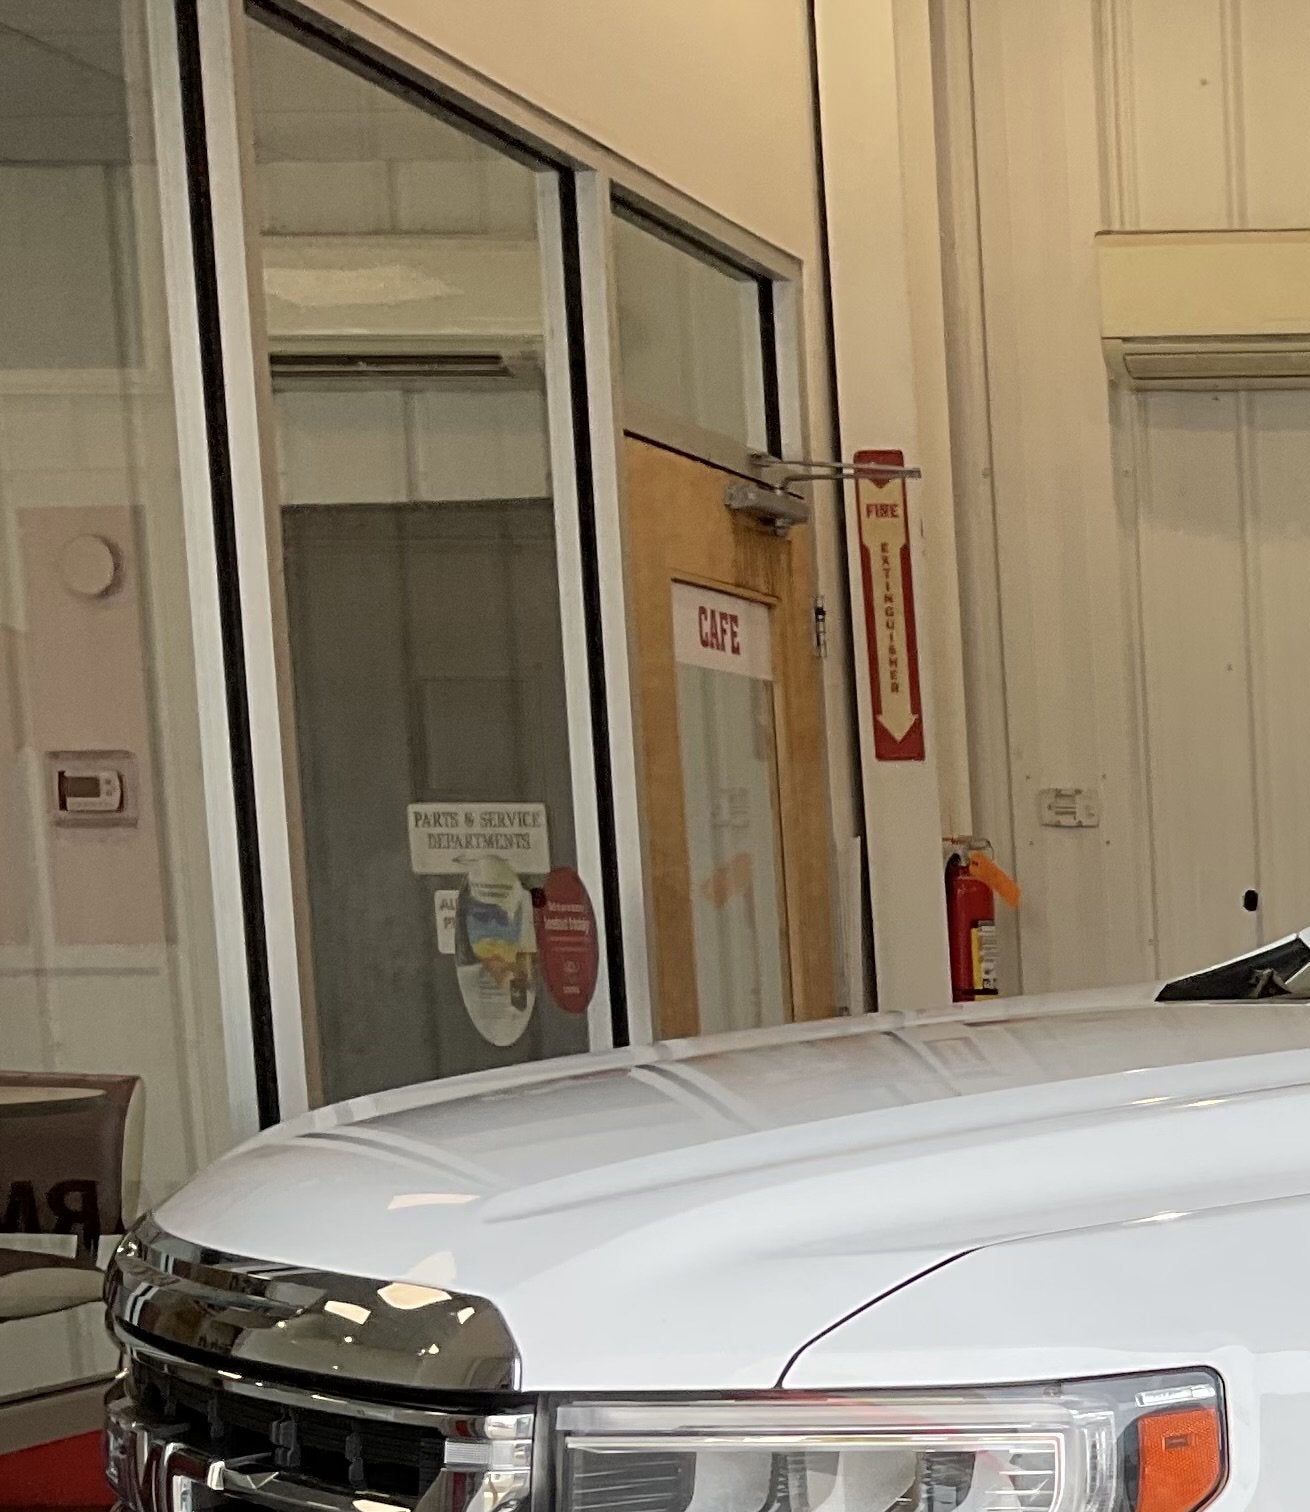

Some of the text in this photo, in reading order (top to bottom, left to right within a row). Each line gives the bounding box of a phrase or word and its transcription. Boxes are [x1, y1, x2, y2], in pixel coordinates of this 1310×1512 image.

[866, 503, 900, 518] FIRE
[880, 542, 900, 694] EXTINGUISHER
[698, 606, 741, 655] CAFE
[413, 811, 541, 828] PARTS & SERVICE
[427, 833, 532, 849] DEPARTMENTS
